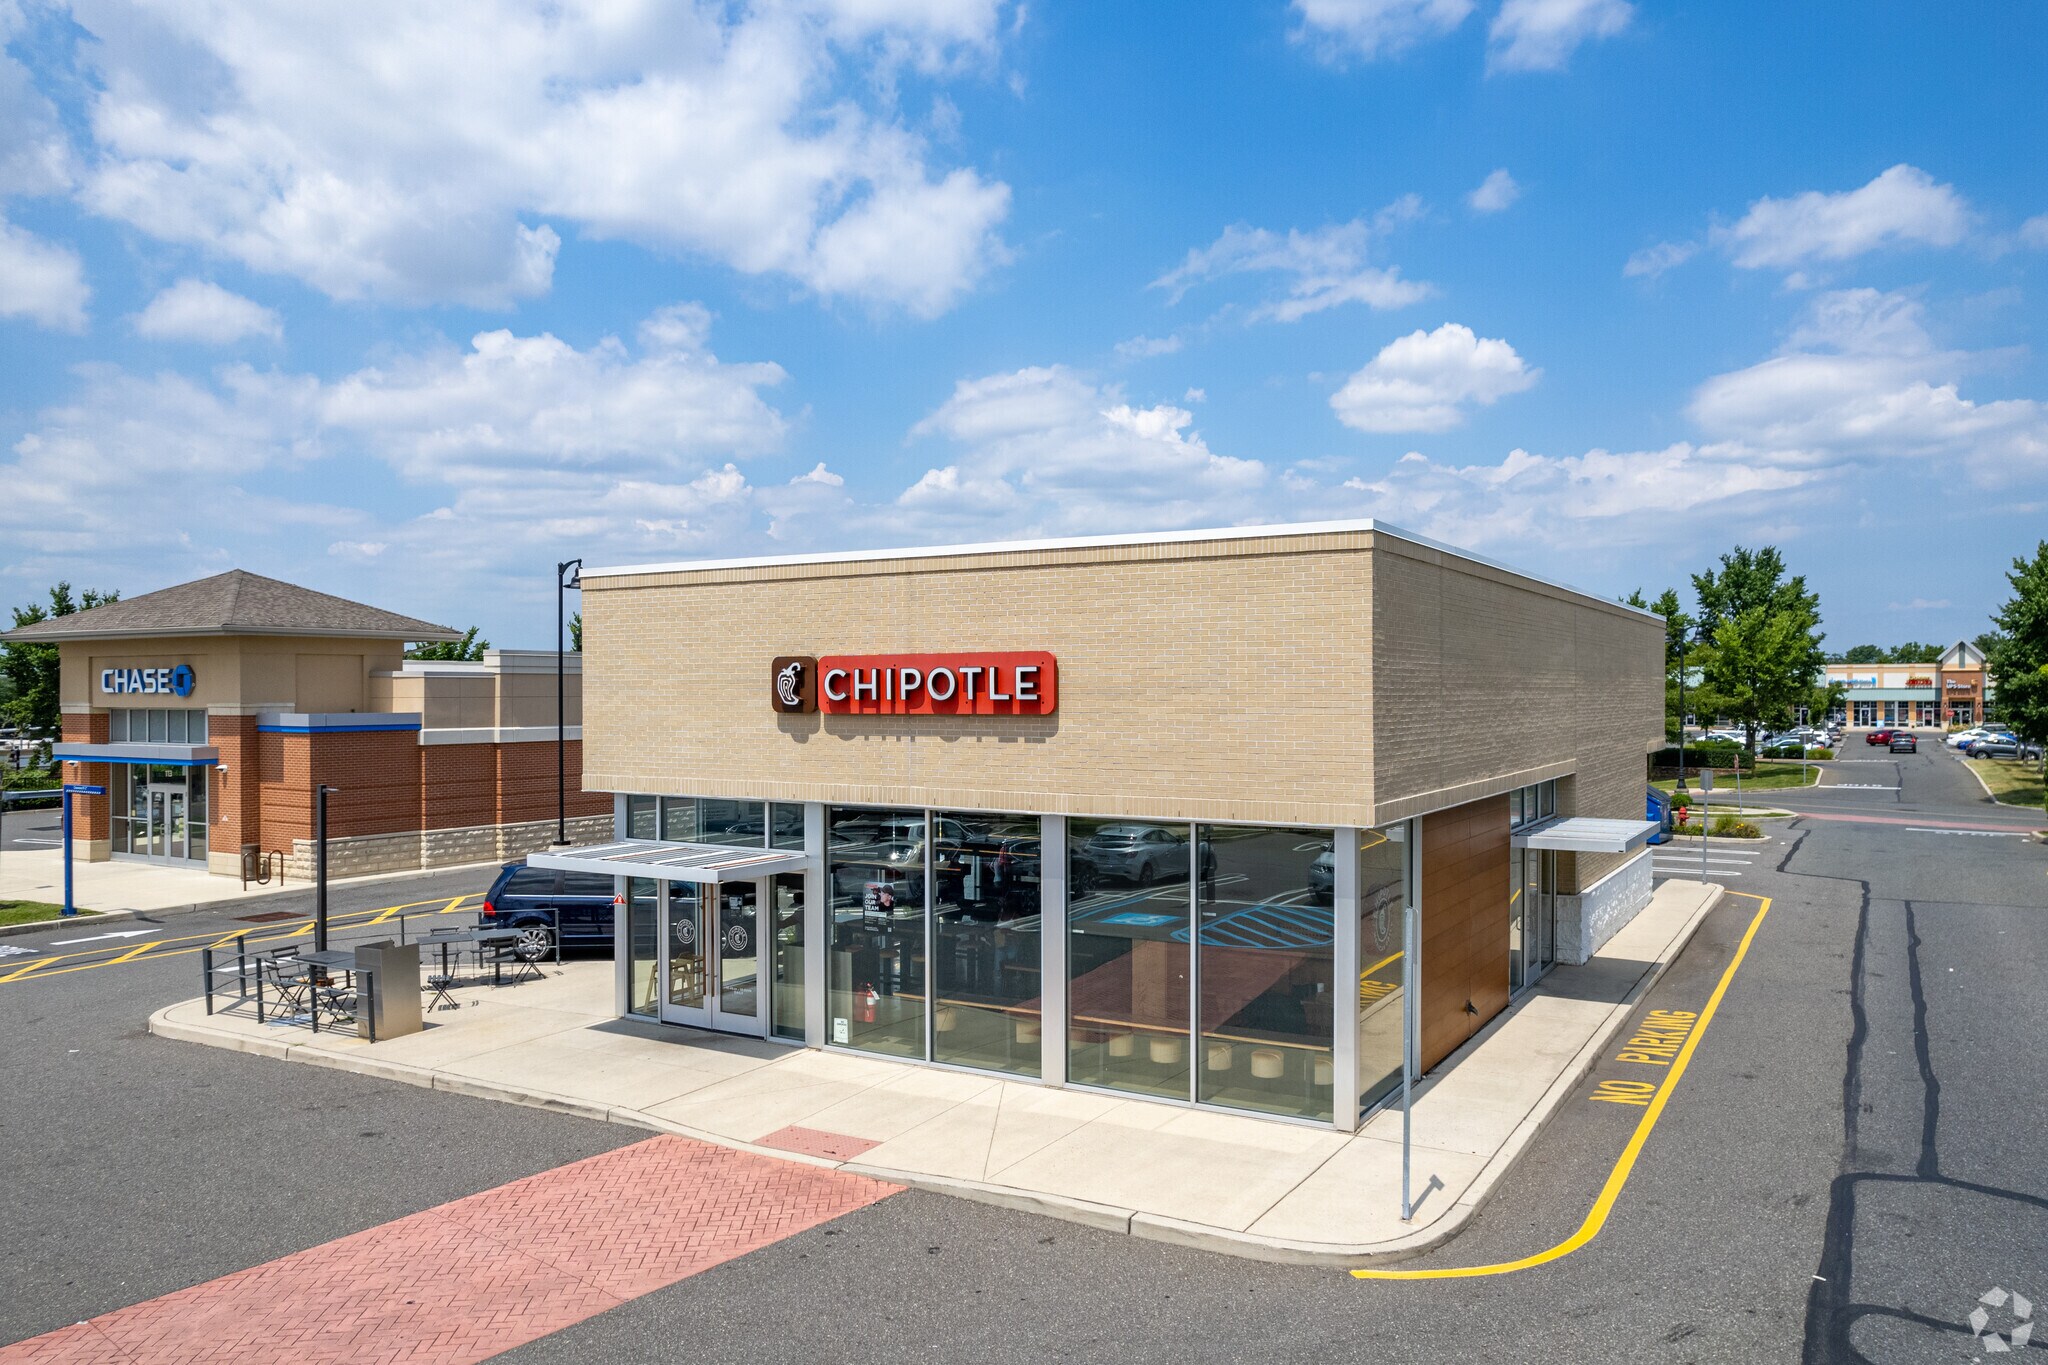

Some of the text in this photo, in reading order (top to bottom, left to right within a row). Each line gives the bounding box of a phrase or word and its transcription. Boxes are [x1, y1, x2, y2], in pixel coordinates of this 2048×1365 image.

[101, 669, 171, 693] CHASE
[823, 665, 1040, 701] CHIPOTLE
[1588, 1009, 1697, 1106] NO PARKING
